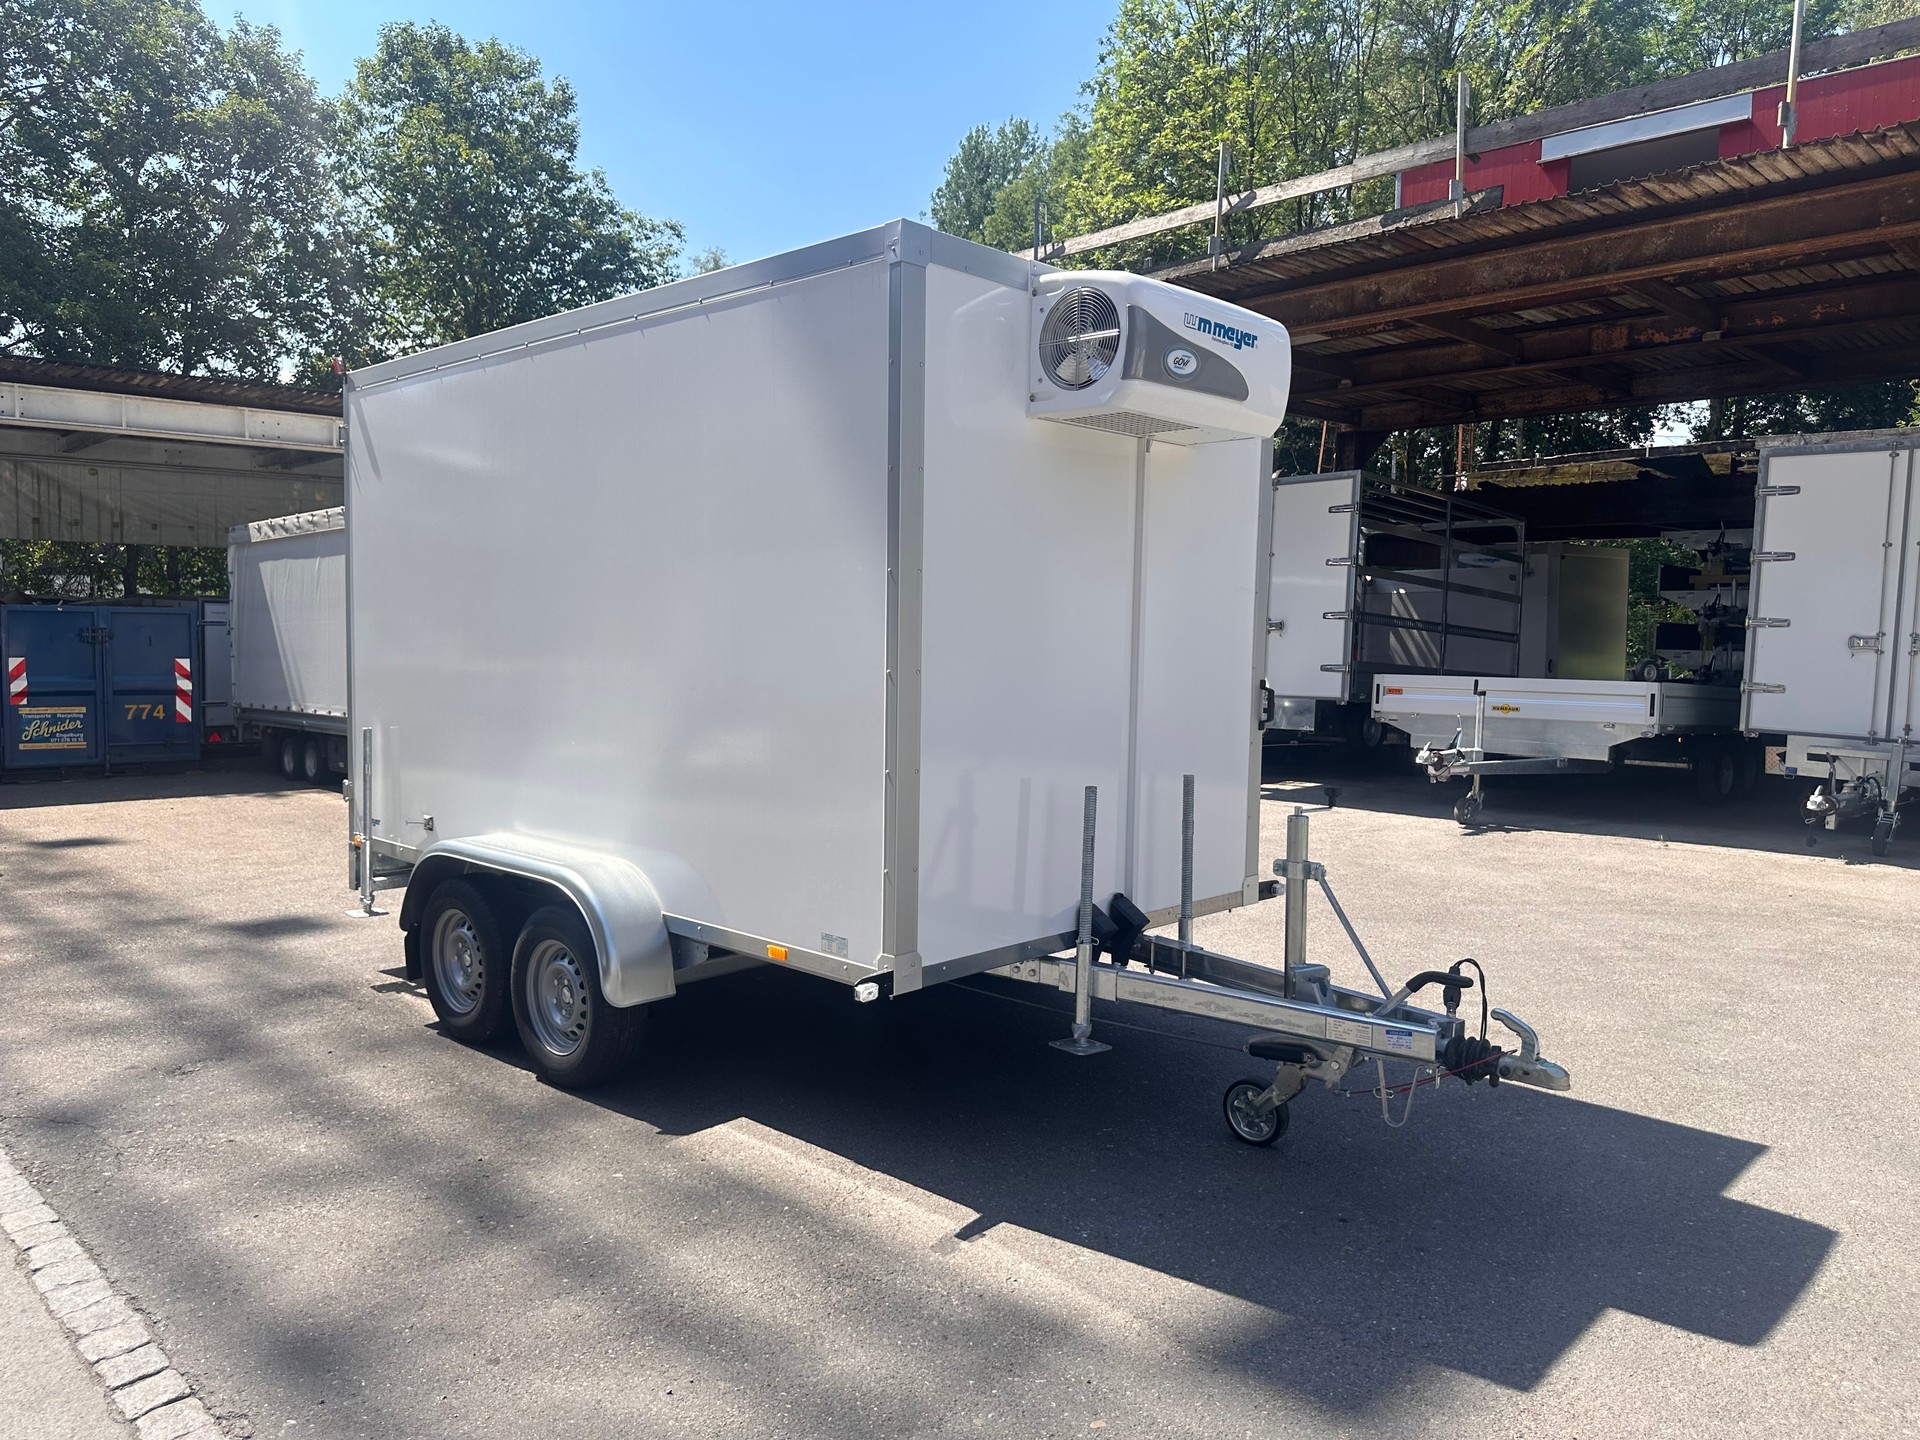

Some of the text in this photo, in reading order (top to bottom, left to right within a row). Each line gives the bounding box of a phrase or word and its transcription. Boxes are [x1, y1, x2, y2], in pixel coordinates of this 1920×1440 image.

[1212, 321, 1258, 350] meyer
[124, 704, 165, 720] 774
[22, 719, 83, 741] Schnider
